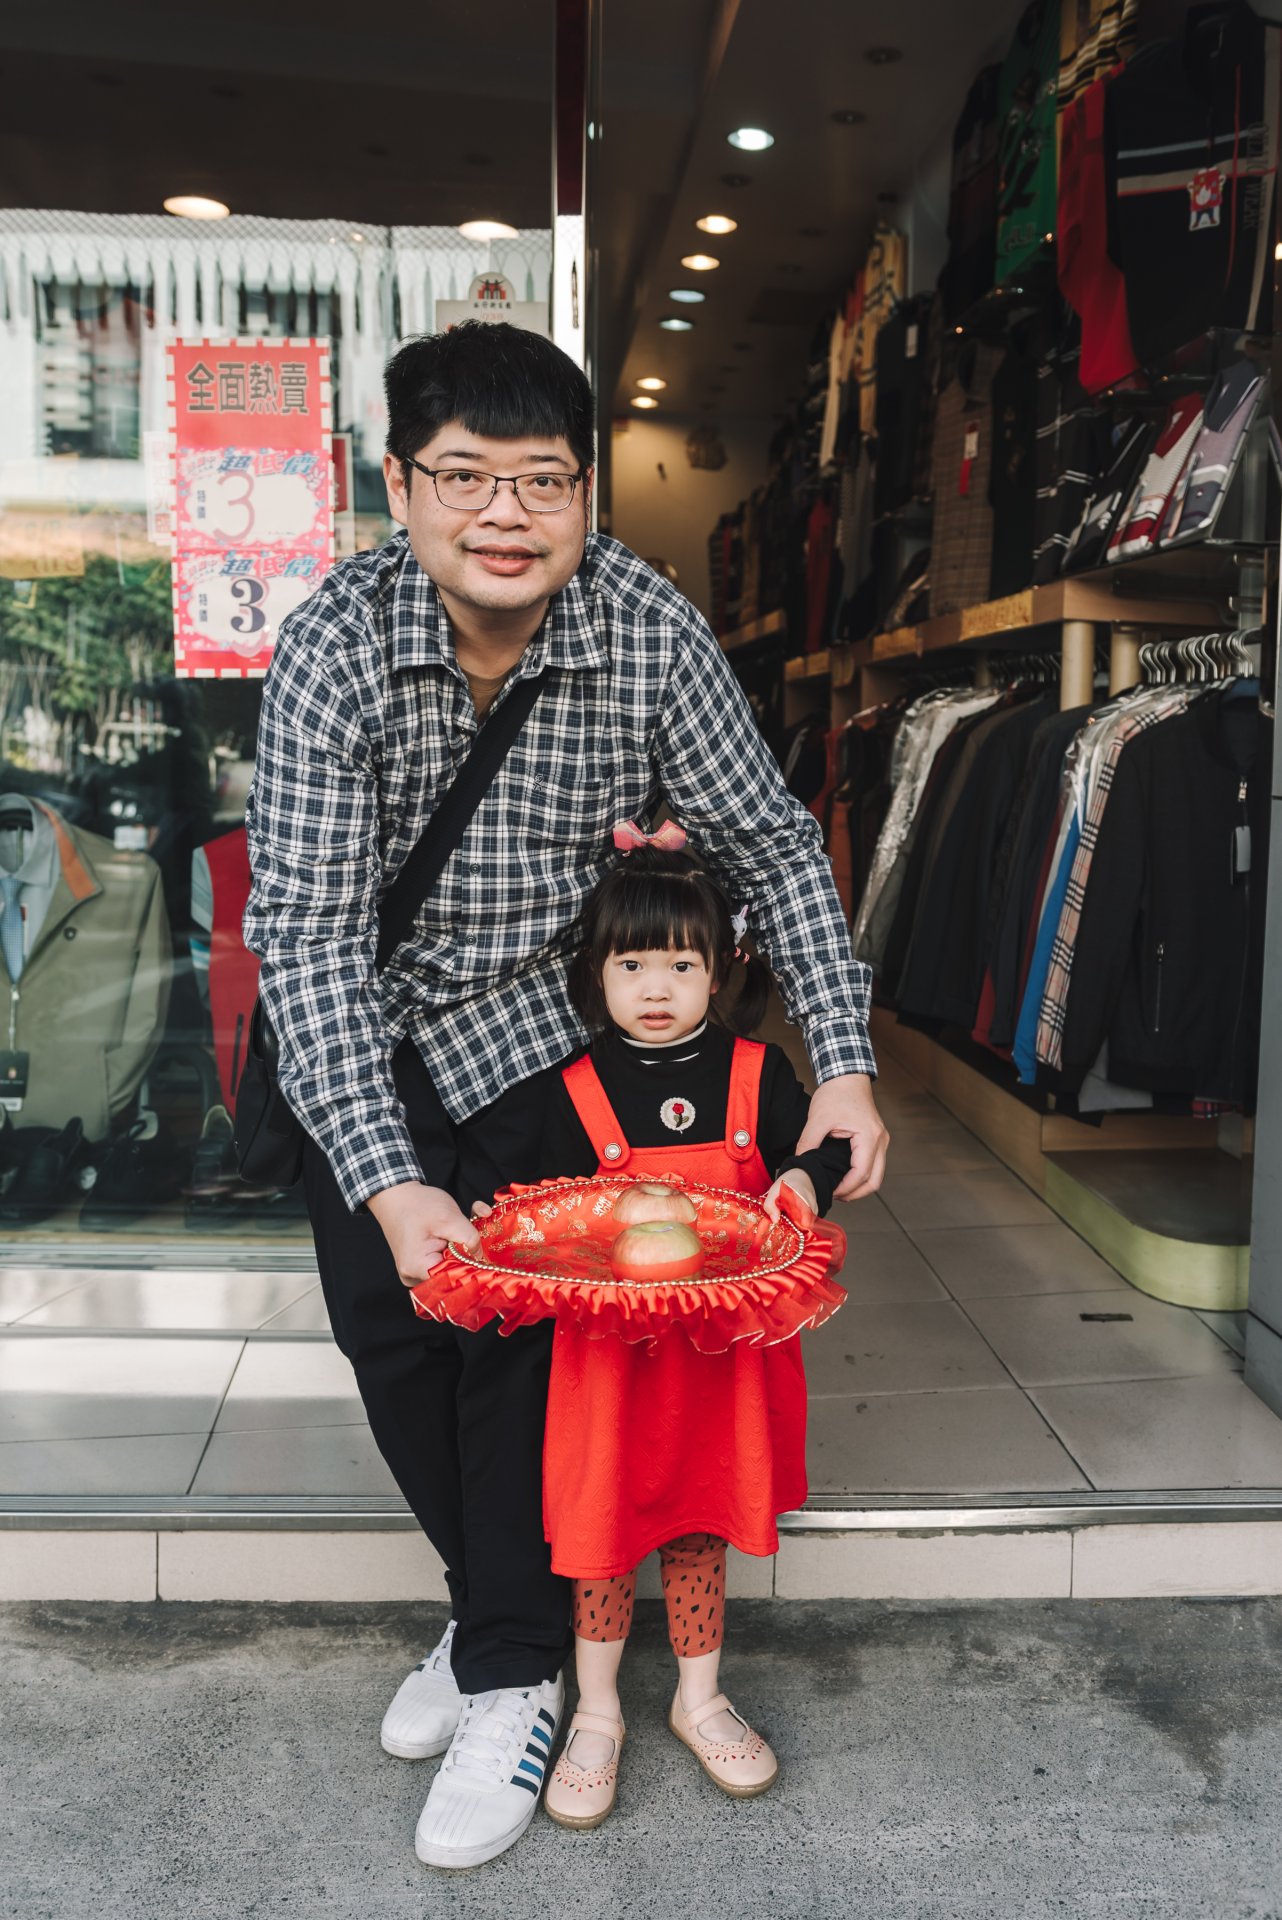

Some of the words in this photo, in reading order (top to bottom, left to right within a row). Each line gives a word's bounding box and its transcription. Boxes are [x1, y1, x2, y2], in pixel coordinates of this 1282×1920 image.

[186, 361, 309, 416] 全面熱賣
[217, 455, 319, 478] 超低價
[213, 471, 255, 542] 3
[219, 557, 320, 578] 超低價
[231, 578, 266, 633] 3
